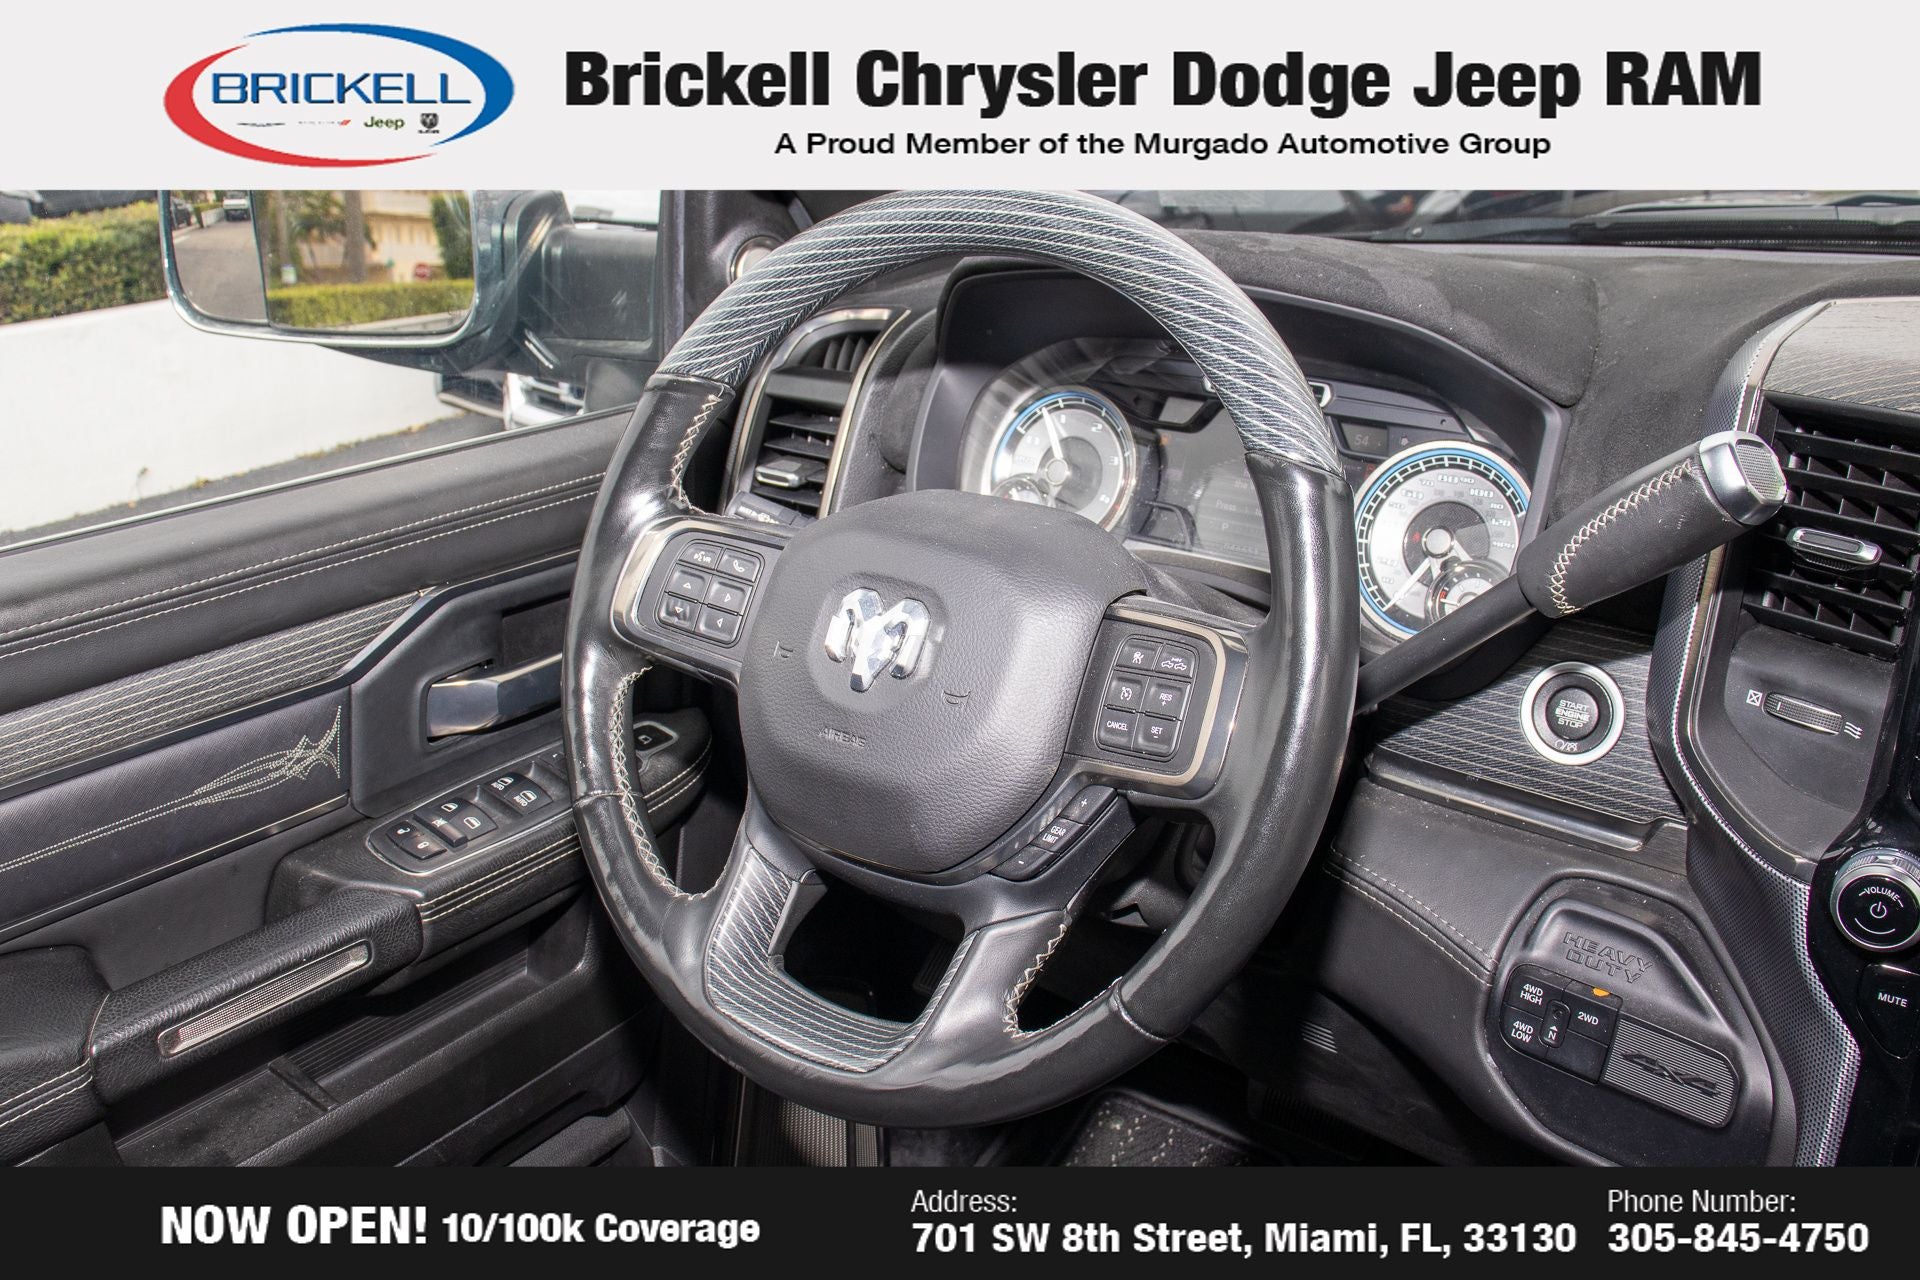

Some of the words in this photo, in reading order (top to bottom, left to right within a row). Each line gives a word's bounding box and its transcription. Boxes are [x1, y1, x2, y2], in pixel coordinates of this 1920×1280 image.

[1091, 423, 1103, 433] 2
[1159, 693, 1173, 701] RES
[1560, 699, 1589, 711] START
[1555, 707, 1590, 721] ENGINE
[1106, 720, 1128, 731] CANCEL
[1558, 717, 1584, 728] STOP
[1151, 726, 1163, 735] SET
[1050, 826, 1067, 836] GEAR
[1042, 833, 1059, 844] LIMIT
[1863, 886, 1901, 902] VOLUME
[1563, 931, 1653, 973] HEAVY
[1565, 949, 1643, 984] DUTY
[1523, 983, 1544, 997] 4WD
[1520, 990, 1543, 1006] HIGH
[1877, 992, 1908, 1008] MUTE
[1577, 1011, 1599, 1025] 2WD
[1513, 1020, 1534, 1035] 4WD
[1511, 1028, 1532, 1043] LOW
[1548, 1031, 1557, 1041] N
